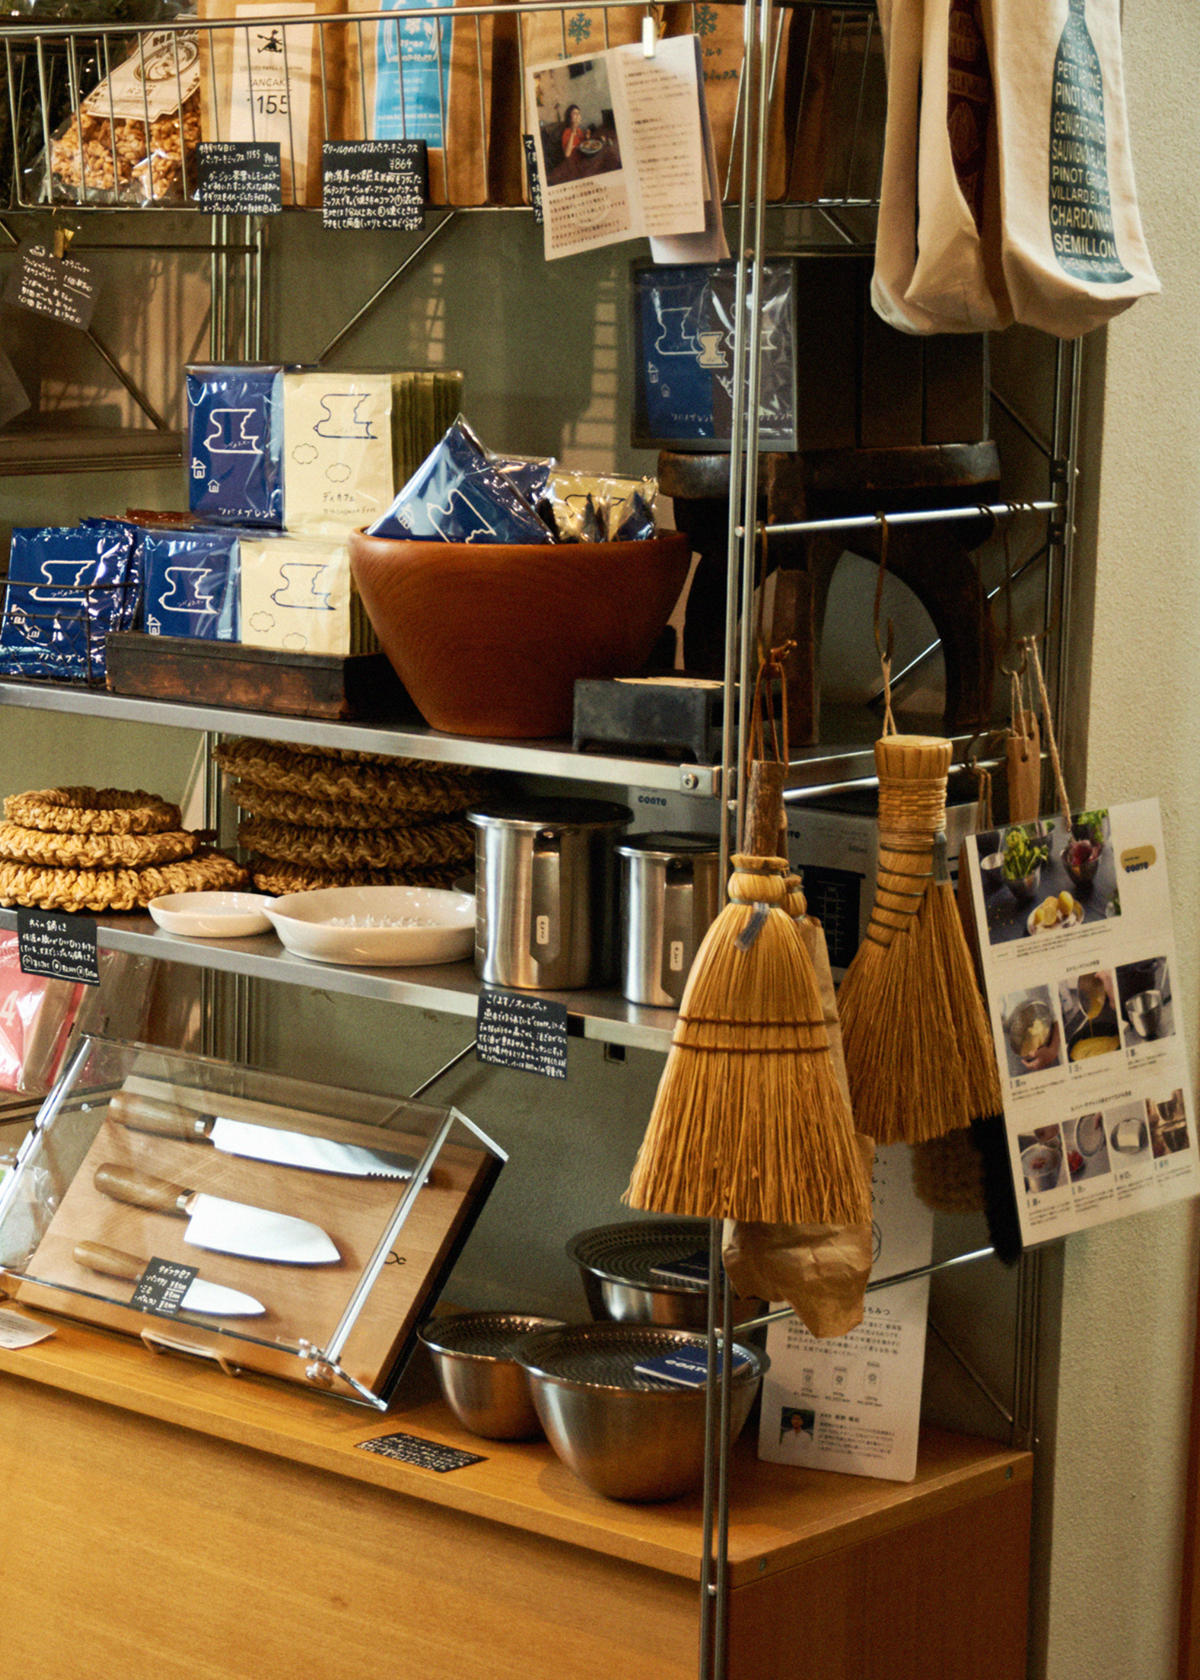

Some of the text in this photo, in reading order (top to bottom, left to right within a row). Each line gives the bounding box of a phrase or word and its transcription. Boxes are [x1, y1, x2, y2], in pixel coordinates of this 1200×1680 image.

[390, 158, 413, 170] ¥864
[1052, 165, 1083, 183] PINOT
[1051, 185, 1089, 203] VILLARD
[1054, 230, 1118, 259] SÉMILLON
